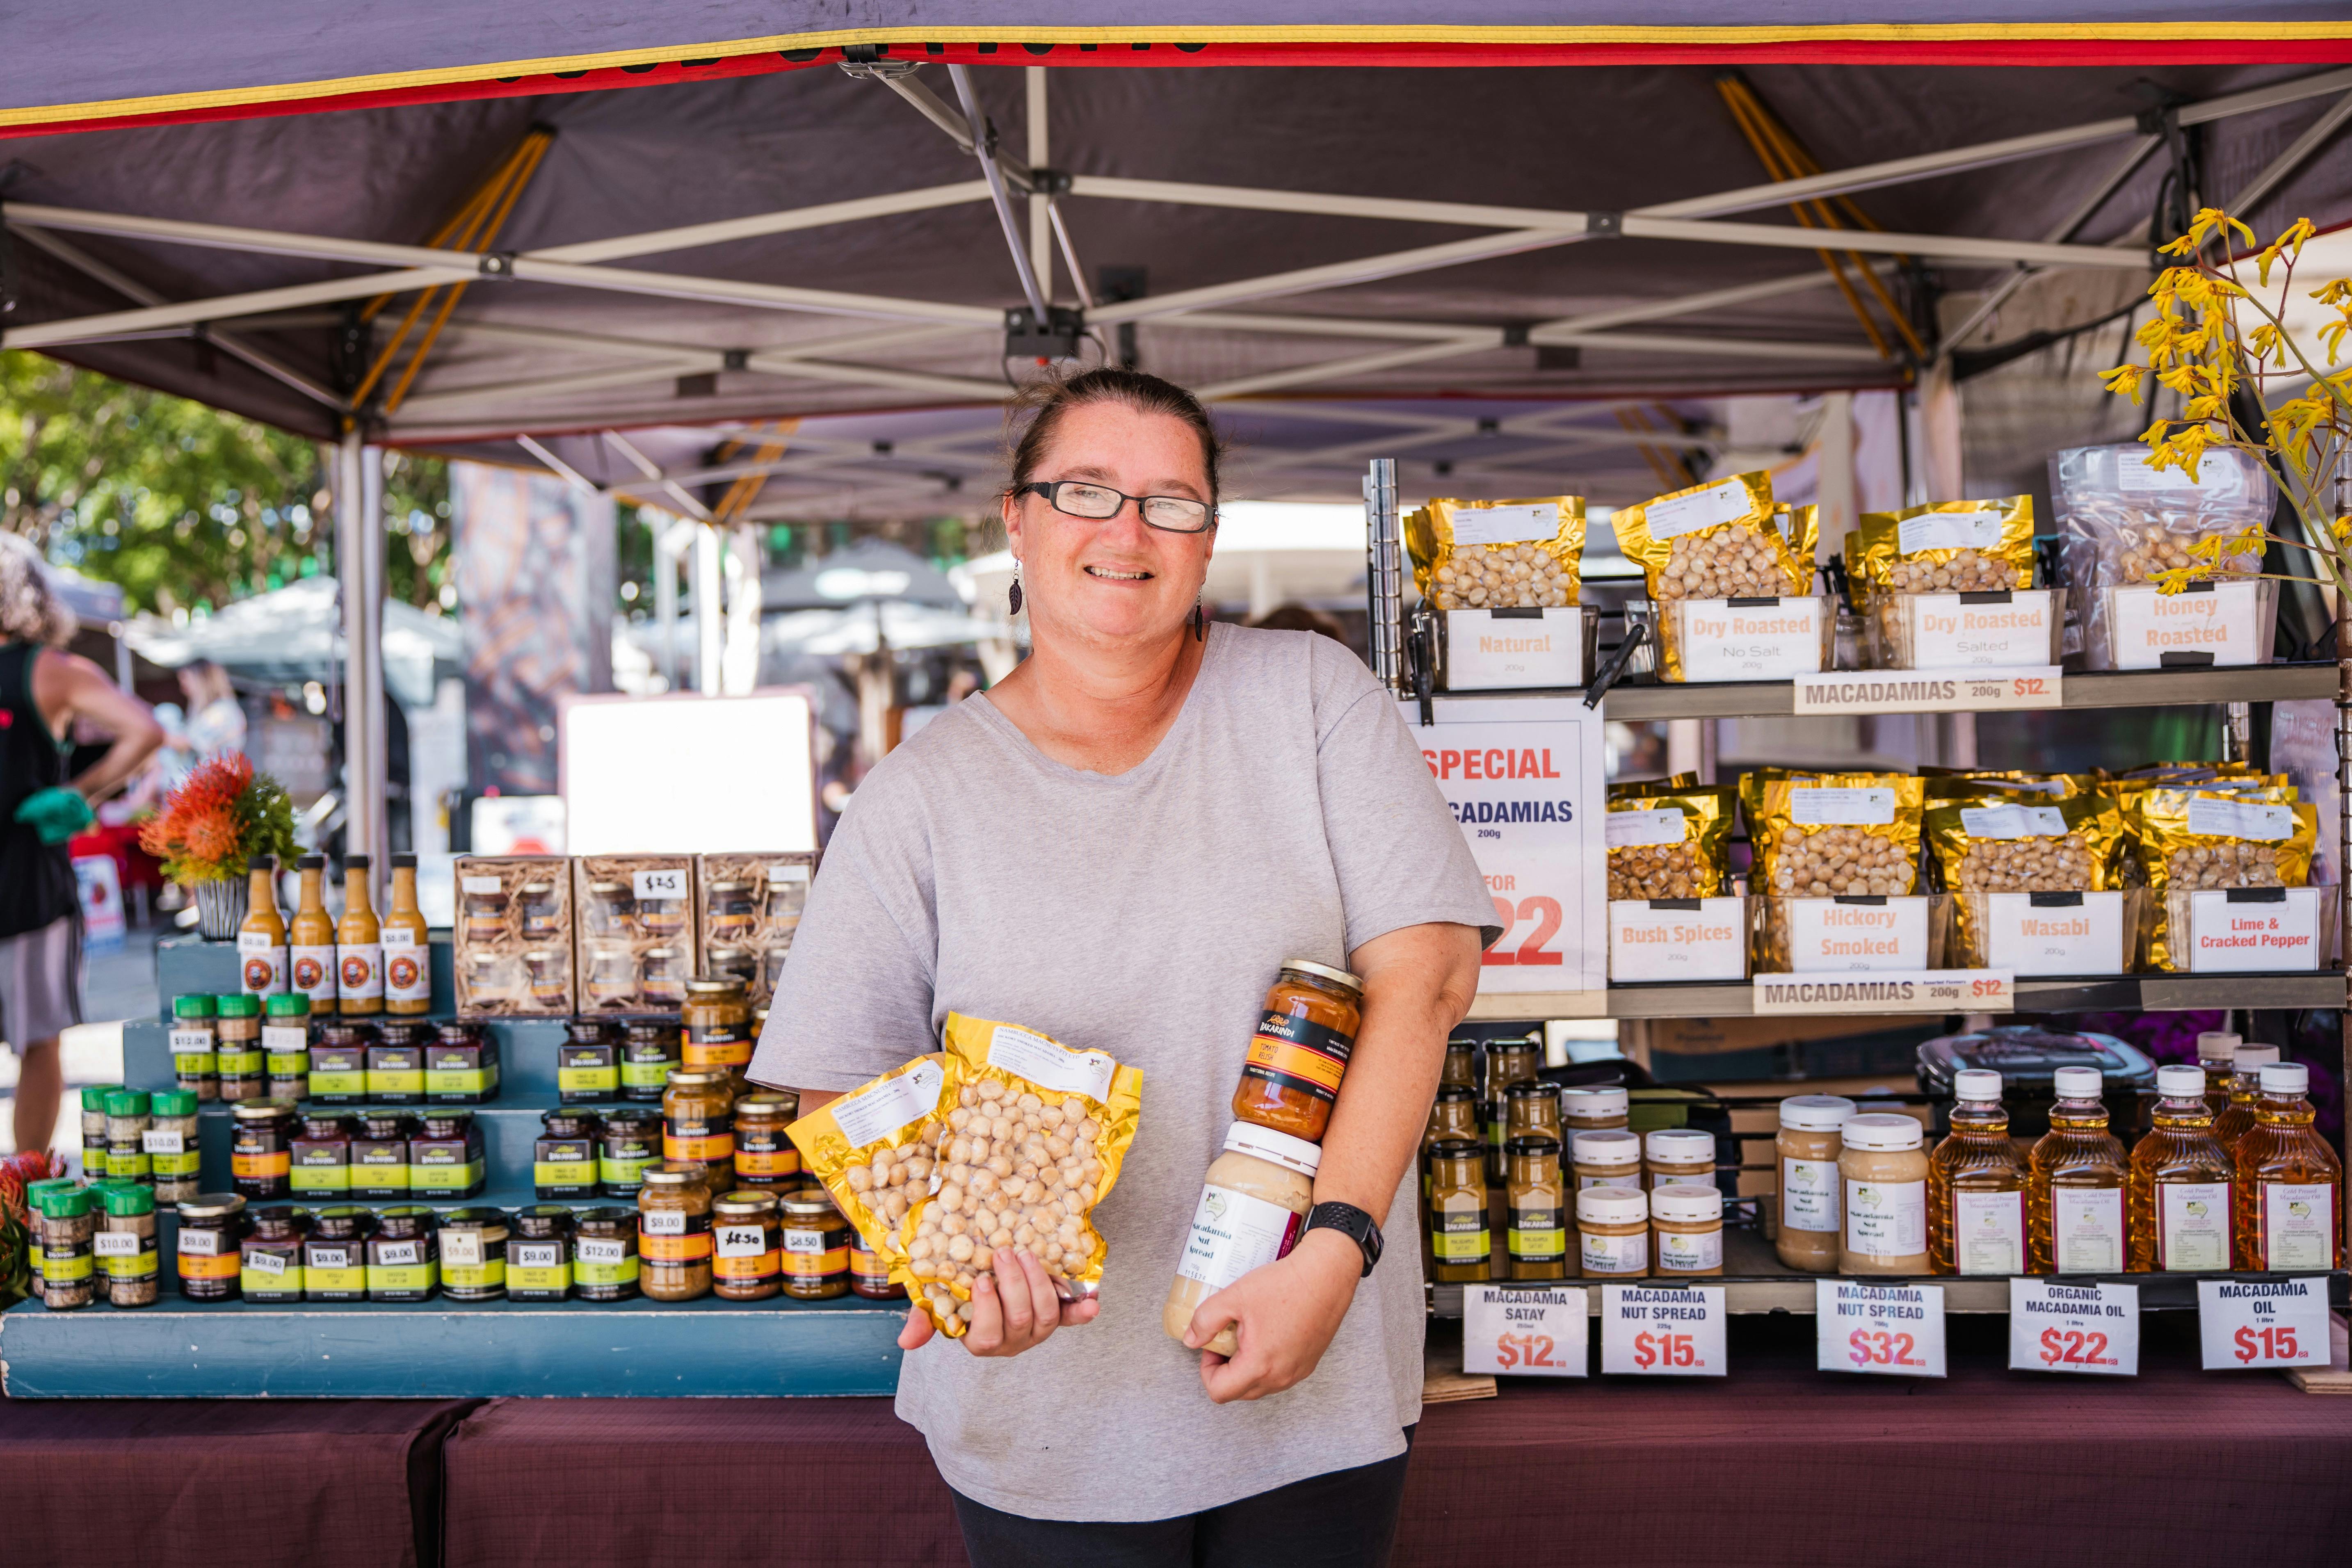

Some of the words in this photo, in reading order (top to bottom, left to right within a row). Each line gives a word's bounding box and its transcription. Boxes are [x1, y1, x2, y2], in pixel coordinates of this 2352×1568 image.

[2154, 599, 2217, 616] Honey
[1694, 619, 1726, 639] Dry
[1733, 616, 1810, 635] Roasted
[1924, 614, 1957, 635] Dry
[1964, 609, 2042, 629] Roasted
[2147, 624, 2228, 646] Roasted
[1480, 635, 1550, 653] Natural
[1723, 647, 1745, 657] No
[1750, 646, 1781, 657] Salt
[1957, 640, 2008, 653] Salted
[1806, 680, 1956, 704] MACADAMIAS
[1972, 687, 2001, 698] 200g
[1421, 749, 1560, 780] SPECIAL
[1478, 829, 1501, 839] 200g
[646, 876, 676, 892] $25
[1483, 875, 1515, 890] FOR
[1824, 909, 1897, 929] Hickory
[2231, 918, 2264, 931] Lime
[2269, 918, 2279, 930] &
[1623, 925, 1667, 943] Bush
[1674, 924, 1732, 944] Spices
[2021, 918, 2089, 936] Wasabi
[1822, 938, 1899, 956] Smoked
[2201, 936, 2256, 948] Cracked
[2261, 935, 2309, 947] Pepper
[1765, 981, 1914, 1003] MACADAMIAS
[1931, 987, 1959, 998] 200g
[1260, 1022, 1295, 1037] BAKARINDI
[999, 1027, 1032, 1040] NAMBUCCA
[1033, 1038, 1059, 1052] MACNUTS
[1034, 1043, 1055, 1058] MACADAMIA
[1260, 1043, 1278, 1053] TOMATO
[1258, 1052, 1274, 1061] RELISH
[834, 1099, 861, 1114] NAMBUCCA
[861, 1084, 888, 1101] MACNUTS
[854, 1105, 868, 1113] SMOKED
[868, 1092, 891, 1107] MACADAMIA
[651, 1217, 679, 1227] $9.00
[1192, 1222, 1231, 1240] Macadamia
[100, 1239, 132, 1248] $10.00
[184, 1236, 210, 1247] $9.00
[791, 1236, 817, 1246] $8.50
[1198, 1235, 1210, 1245] Nut
[315, 1253, 343, 1263] $9.00
[384, 1249, 412, 1259] $9.00
[524, 1251, 551, 1261] $9.00
[586, 1246, 618, 1257] $12.00
[1189, 1245, 1214, 1259] Spread
[255, 1256, 281, 1269] $9.00
[1484, 1291, 1566, 1305] MACADAMIA
[1622, 1290, 1705, 1303] MACADAMIA
[1838, 1286, 1923, 1302] MACADAMIA
[2049, 1288, 2102, 1301] ORGANIC
[2220, 1284, 2307, 1298] MACADAMIA
[1505, 1309, 1544, 1320] SATAY
[1622, 1307, 1647, 1319] NUT
[1653, 1308, 1706, 1320] SPREAD
[1838, 1304, 1863, 1316] NUT
[1869, 1305, 1924, 1319] SPREAD
[2027, 1301, 2101, 1316] MACADAMIA
[2107, 1305, 2125, 1317] OIL
[2253, 1301, 2275, 1313] OIL
[1497, 1331, 1554, 1369] $12
[1635, 1331, 1694, 1369] $15
[1850, 1328, 1914, 1366] $32
[2040, 1326, 2108, 1365] $22
[2234, 1326, 2298, 1364] $15
